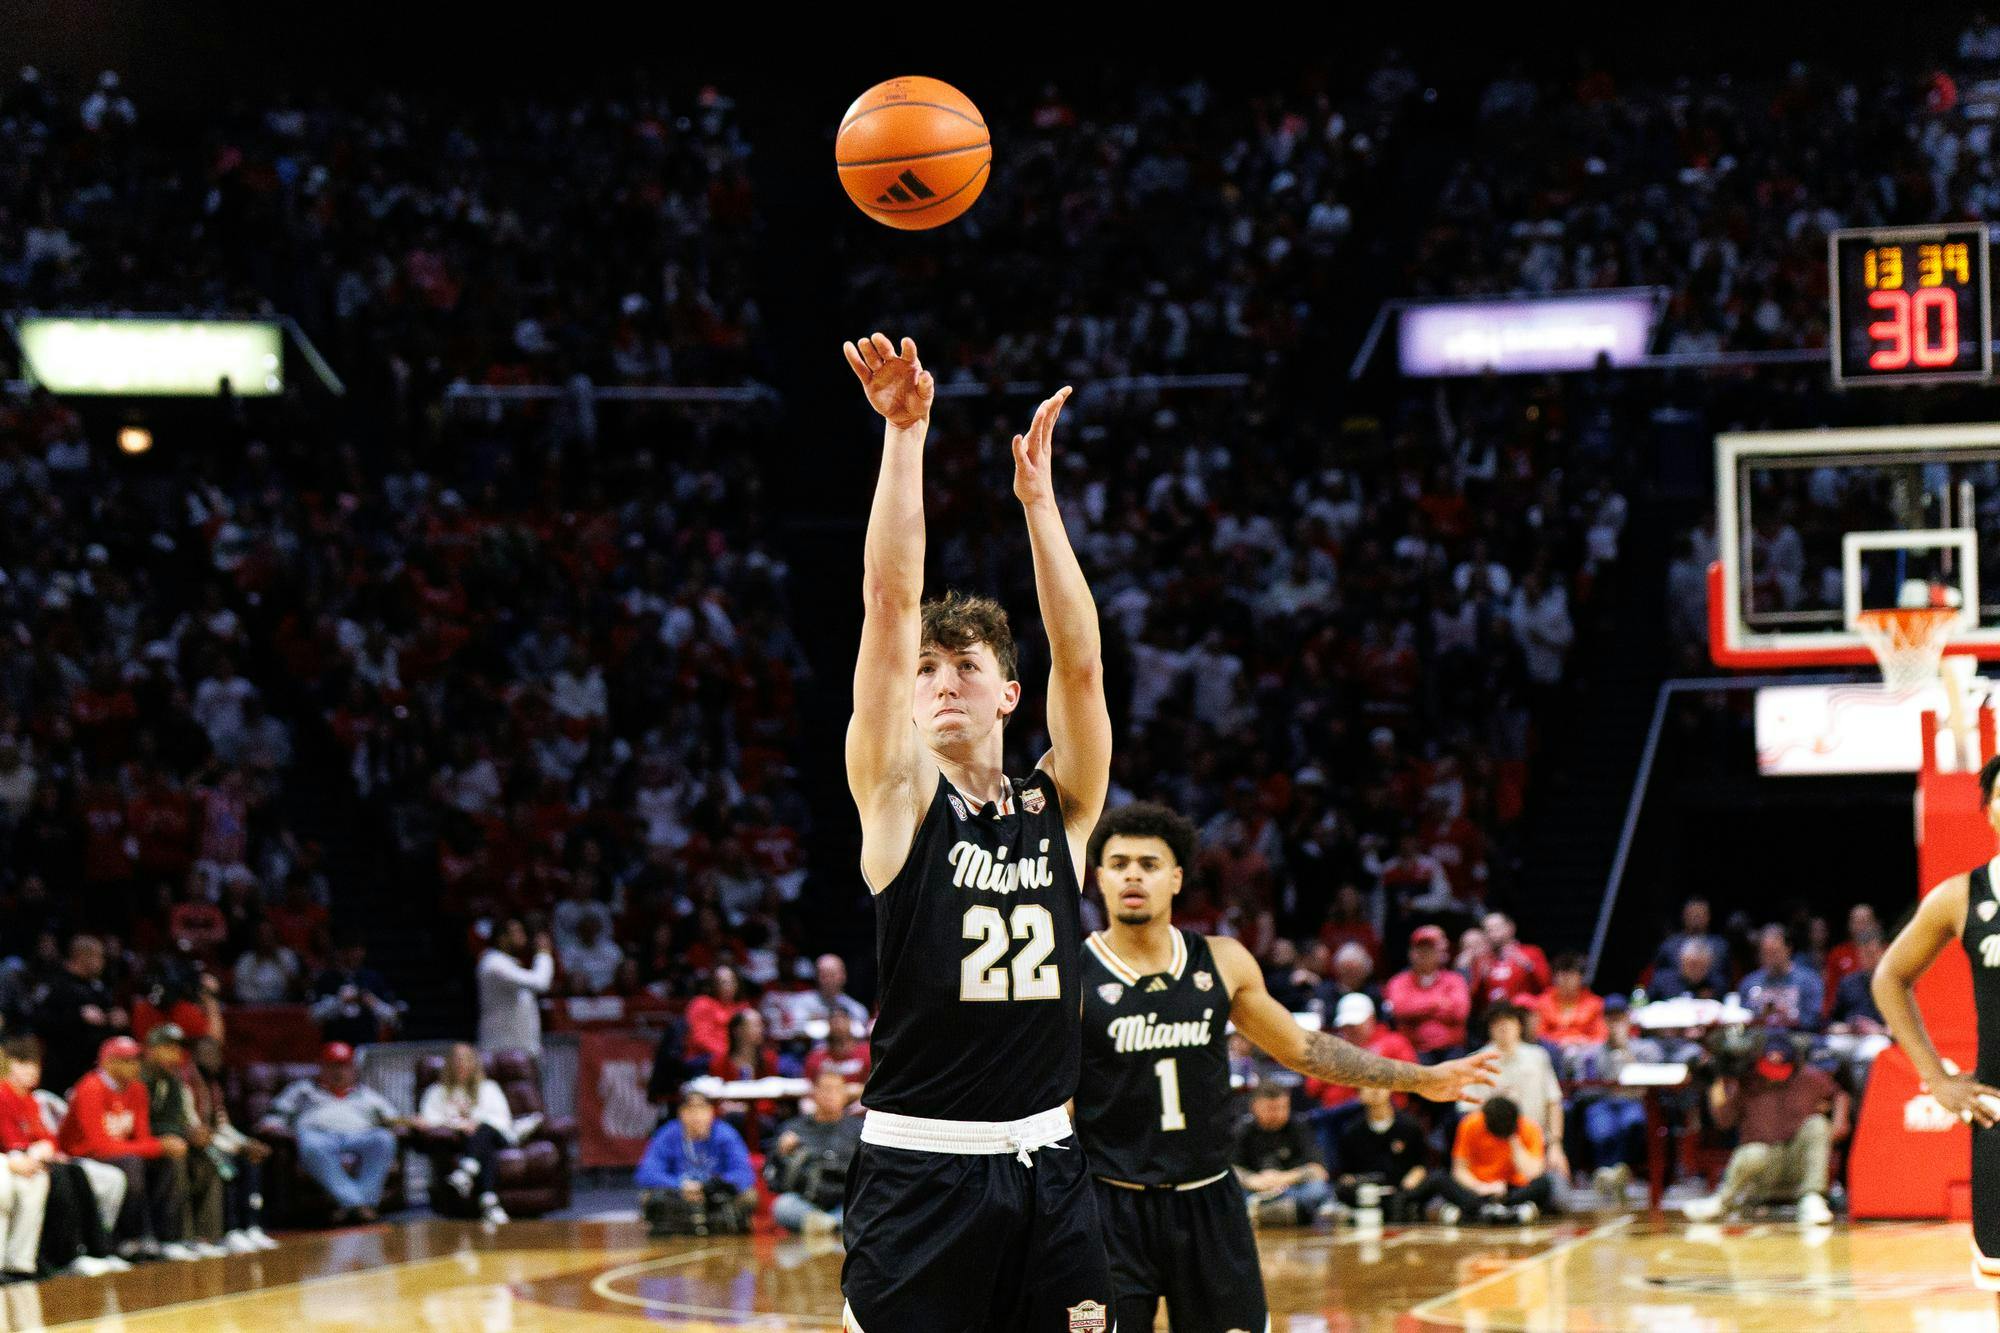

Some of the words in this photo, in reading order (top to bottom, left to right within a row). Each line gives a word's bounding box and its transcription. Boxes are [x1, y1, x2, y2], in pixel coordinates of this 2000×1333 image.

[1863, 246, 1904, 289] 13
[1867, 287, 1959, 370] 30
[959, 904, 1061, 1001] 22
[1107, 1008, 1214, 1053] Miami
[1154, 1058, 1186, 1132] 1
